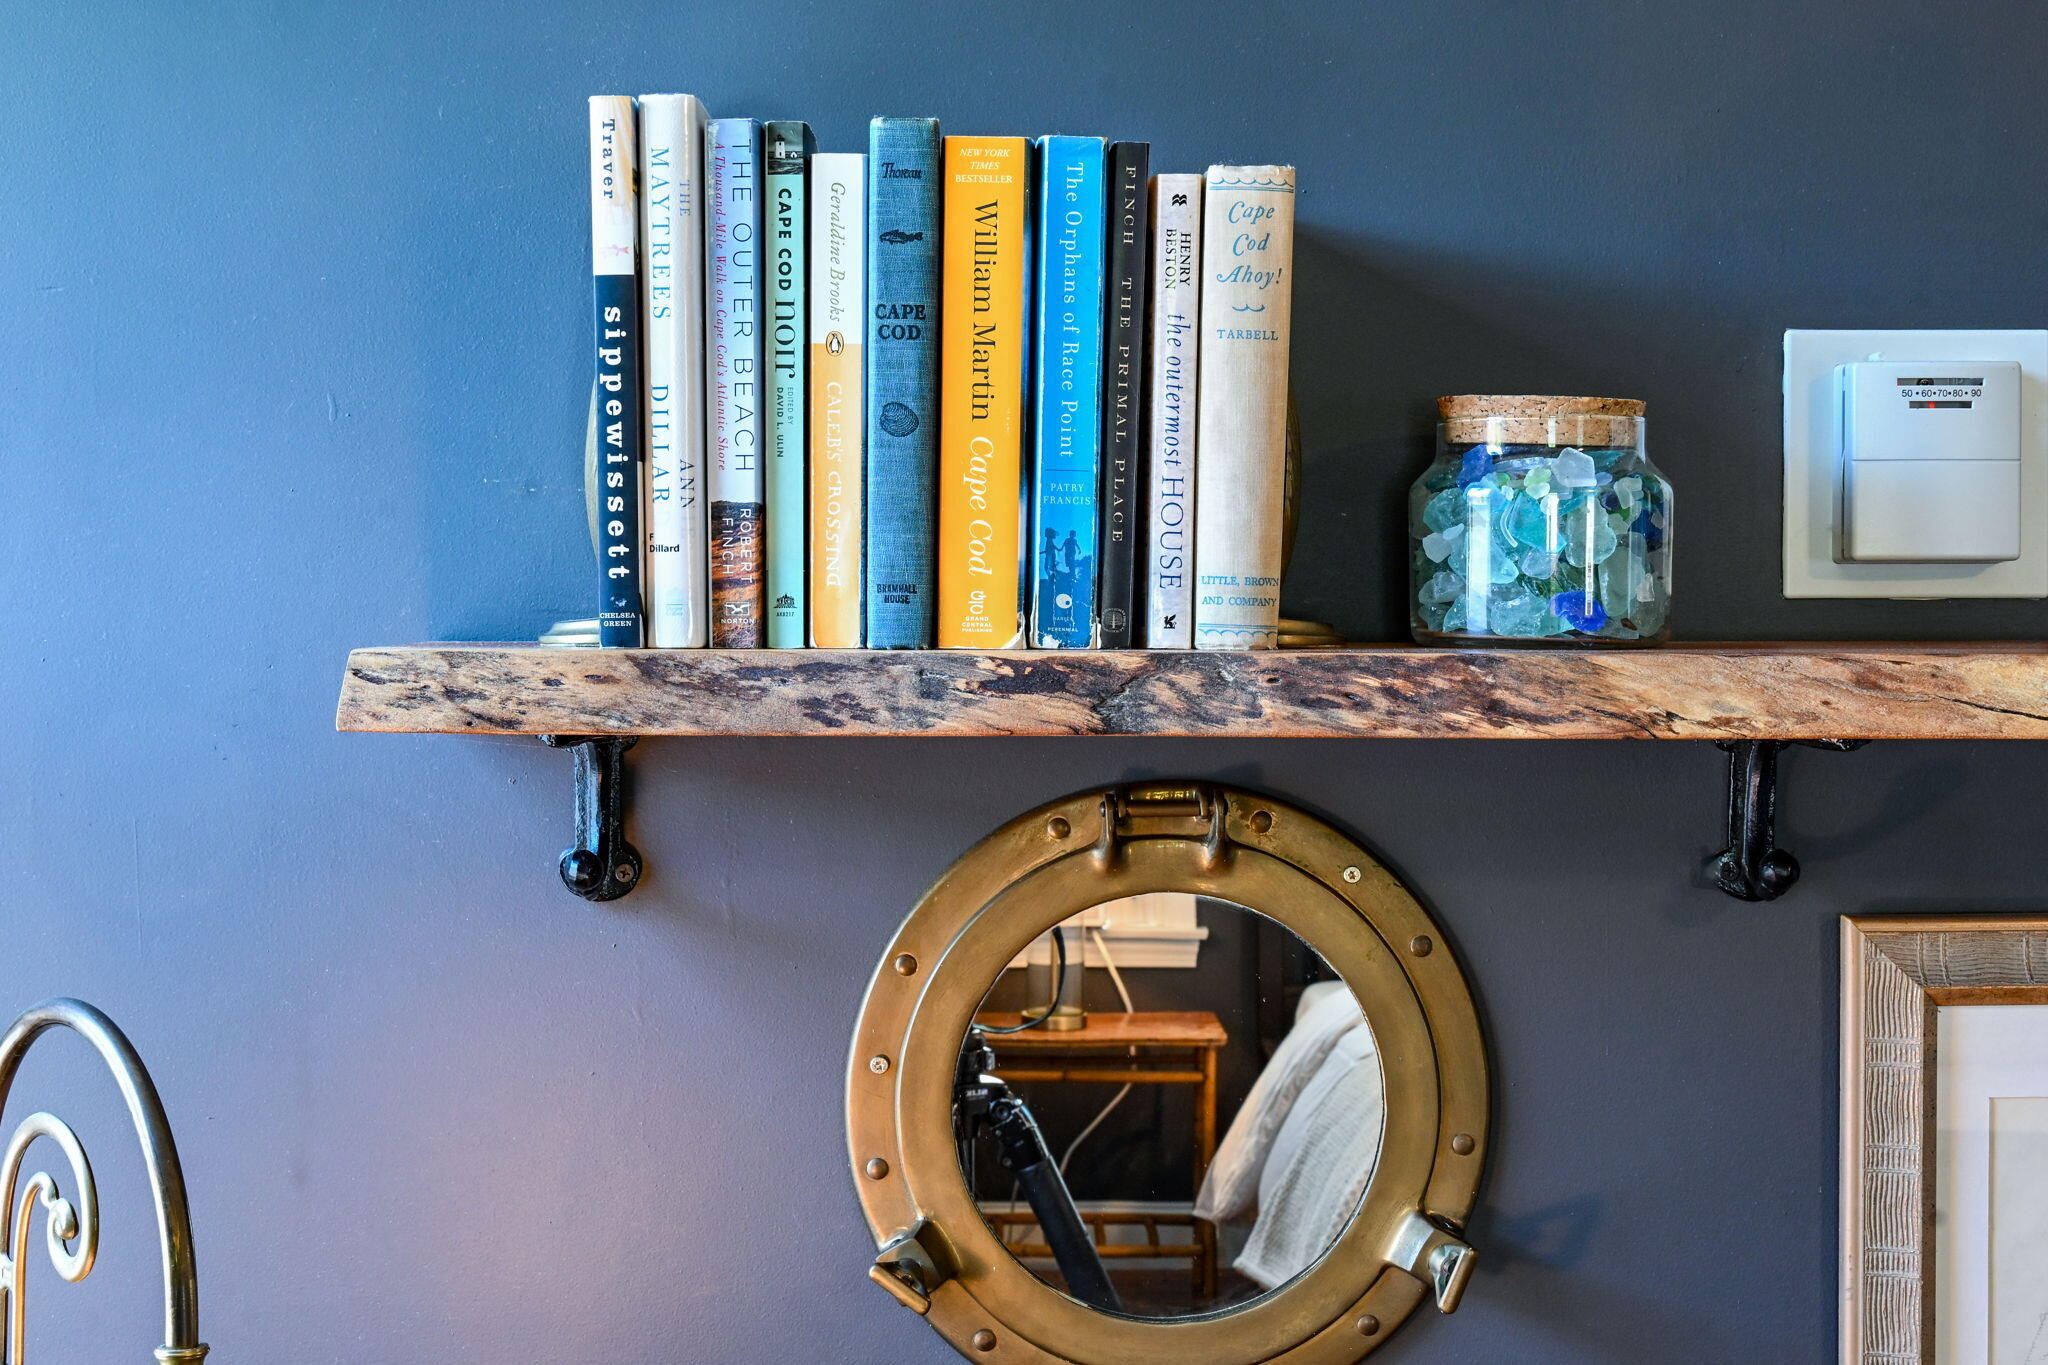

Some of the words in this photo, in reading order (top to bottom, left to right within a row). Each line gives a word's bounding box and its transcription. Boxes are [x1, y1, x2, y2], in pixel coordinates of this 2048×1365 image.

[601, 118, 616, 199] Traver
[732, 139, 752, 202] THE
[881, 162, 923, 179] Thoreau
[959, 148, 983, 157] NEW
[983, 149, 1011, 158] YORK
[969, 161, 1000, 170] TIMES
[679, 179, 691, 217] THE
[955, 174, 1014, 184] BESTSELLER
[1066, 162, 1085, 202] The
[714, 156, 727, 249] Thousand-Mile
[778, 188, 792, 239] CAPE
[830, 182, 846, 265] Geraldine
[1122, 165, 1137, 245] FINCH
[1228, 200, 1276, 225] Cape
[650, 147, 671, 319] MAYTREES
[1232, 232, 1271, 257] Cod
[716, 255, 727, 285] Walk
[778, 248, 792, 291] COD
[973, 199, 998, 315] William
[1060, 211, 1083, 304] Orphans
[1165, 228, 1178, 290] BESTON
[1179, 232, 1192, 286] HENRY
[1216, 265, 1282, 290] Ahoy!
[716, 290, 724, 303] on
[732, 223, 753, 338] OUTER
[829, 270, 845, 323] Brooks
[714, 309, 728, 339] Cape
[875, 303, 927, 321] CAPE
[1063, 312, 1080, 334] of
[1119, 277, 1132, 328] THE
[775, 298, 796, 379] noir
[878, 324, 922, 341] COD
[1166, 314, 1192, 347] the
[1216, 329, 1279, 341] TARBELL
[716, 345, 728, 377] Cod's
[971, 322, 997, 423] Martin
[1061, 342, 1080, 391] Race
[717, 382, 729, 432] Atlantic
[734, 358, 755, 471] BEACH
[776, 387, 784, 418] DAVID
[1115, 345, 1130, 443] PRIMAL
[1164, 355, 1184, 467] outermost
[1901, 389, 1913, 397] 50
[1921, 389, 1932, 397] 60
[1937, 389, 1948, 397] 70
[1952, 389, 1963, 397] 80
[1970, 389, 1982, 397] 90
[599, 306, 630, 579] sippewissett
[776, 422, 784, 430] L.
[787, 416, 794, 426] BY
[826, 382, 844, 462] CALEB'S
[1060, 399, 1079, 457] Point
[717, 437, 729, 471] Shore
[776, 434, 784, 458] ULIN
[963, 436, 994, 511] Cape
[1050, 483, 1085, 493] PATRY
[1043, 495, 1091, 506] FRANCIS
[1112, 458, 1126, 542] PLACE
[649, 545, 680, 553] Dillard
[722, 517, 734, 575] FINCH
[740, 508, 753, 584] ROBERT
[825, 471, 842, 587] CROSSING
[968, 519, 993, 577] Cod
[1159, 476, 1185, 589] HOUSE
[876, 583, 918, 595] BRAMHALL
[883, 594, 911, 605] HOUSE
[1200, 575, 1240, 587] LITTLE,
[1244, 576, 1280, 587] BROWN
[1201, 596, 1224, 606] AND
[1228, 596, 1277, 607] COMPANY
